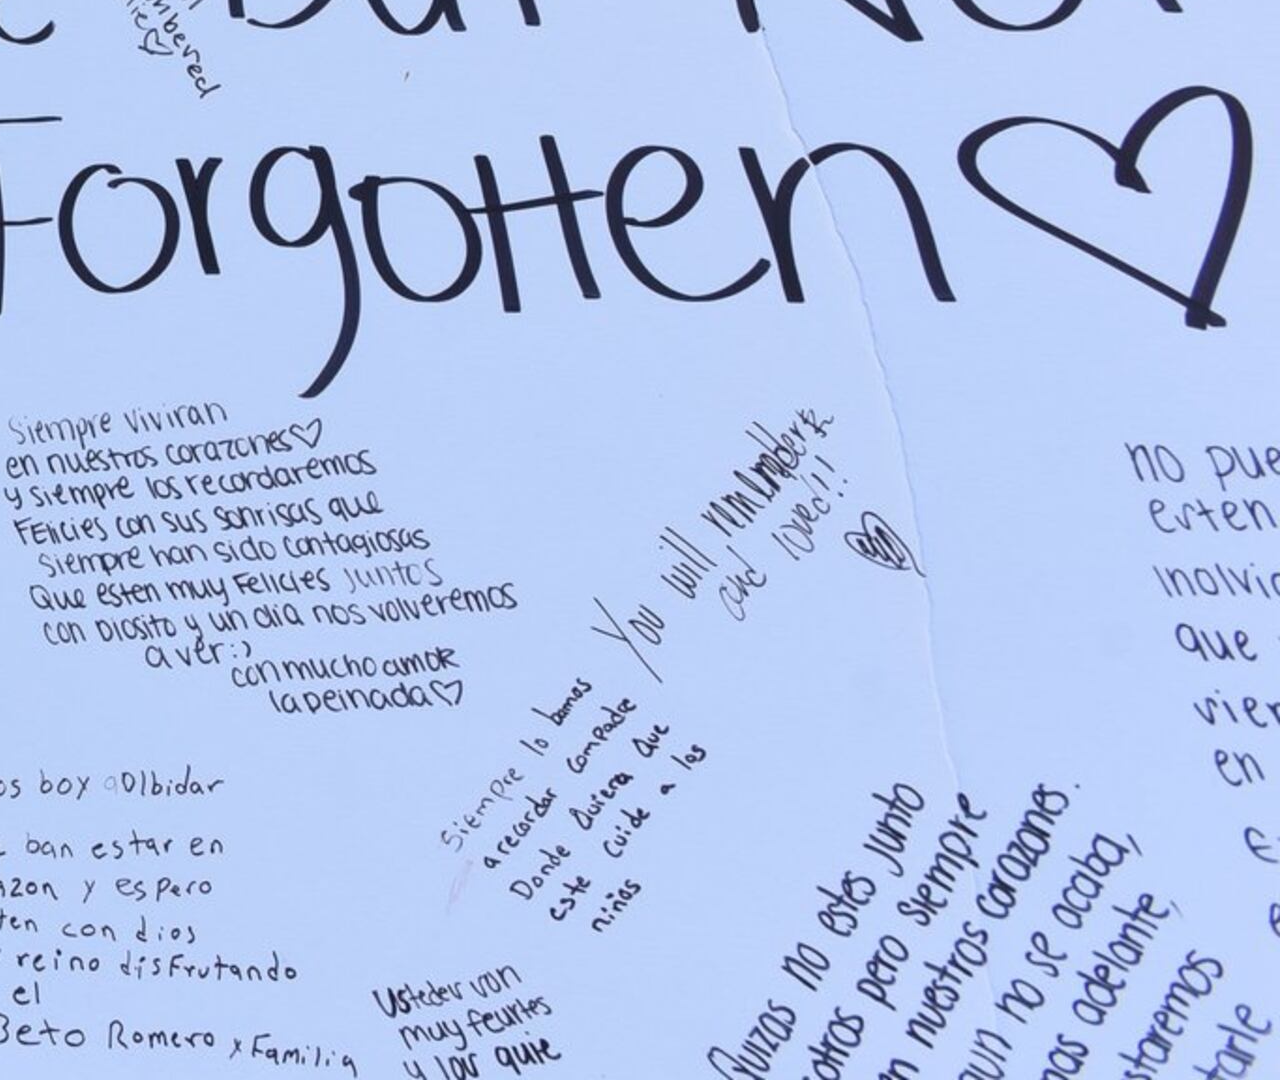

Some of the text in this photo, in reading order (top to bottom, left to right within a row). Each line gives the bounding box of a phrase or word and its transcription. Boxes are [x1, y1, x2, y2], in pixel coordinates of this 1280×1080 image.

[5, 424, 294, 480] en nuestros corazones
[8, 411, 112, 451] Siempre
[28, 442, 378, 511] siempre los recordaremos
[1123, 441, 1186, 484] no
[114, 490, 385, 540] con sus sonrisas que
[148, 543, 209, 568] han
[212, 535, 278, 564] sido
[282, 527, 432, 560] contagiosas
[28, 584, 88, 612] Que
[95, 581, 162, 609] esten
[164, 576, 231, 608] muy
[42, 620, 87, 646] con
[207, 608, 250, 633] un
[311, 602, 367, 626] nos
[367, 575, 519, 623] volveremos
[589, 525, 719, 684] You will
[1174, 622, 1259, 663] que
[230, 653, 378, 689] con mucho
[440, 676, 593, 856] Siempre lo bamos
[669, 743, 707, 771] los
[1213, 748, 1266, 788] en
[25, 832, 74, 860] ban
[90, 828, 174, 860] estar
[189, 836, 224, 858] en
[114, 876, 213, 903] espero
[508, 842, 573, 902] Donde
[780, 782, 926, 993] no estes junto
[61, 922, 117, 942] con
[135, 914, 196, 945] dios
[15, 947, 101, 973] reino
[855, 934, 910, 1012] pero
[993, 977, 1046, 1025] no
[1024, 930, 1069, 979] se
[11, 980, 41, 1007] el
[904, 919, 996, 1056] nuestros
[107, 1019, 215, 1050] Romero
[250, 1032, 358, 1079] Familia
[397, 1018, 469, 1053] muy
